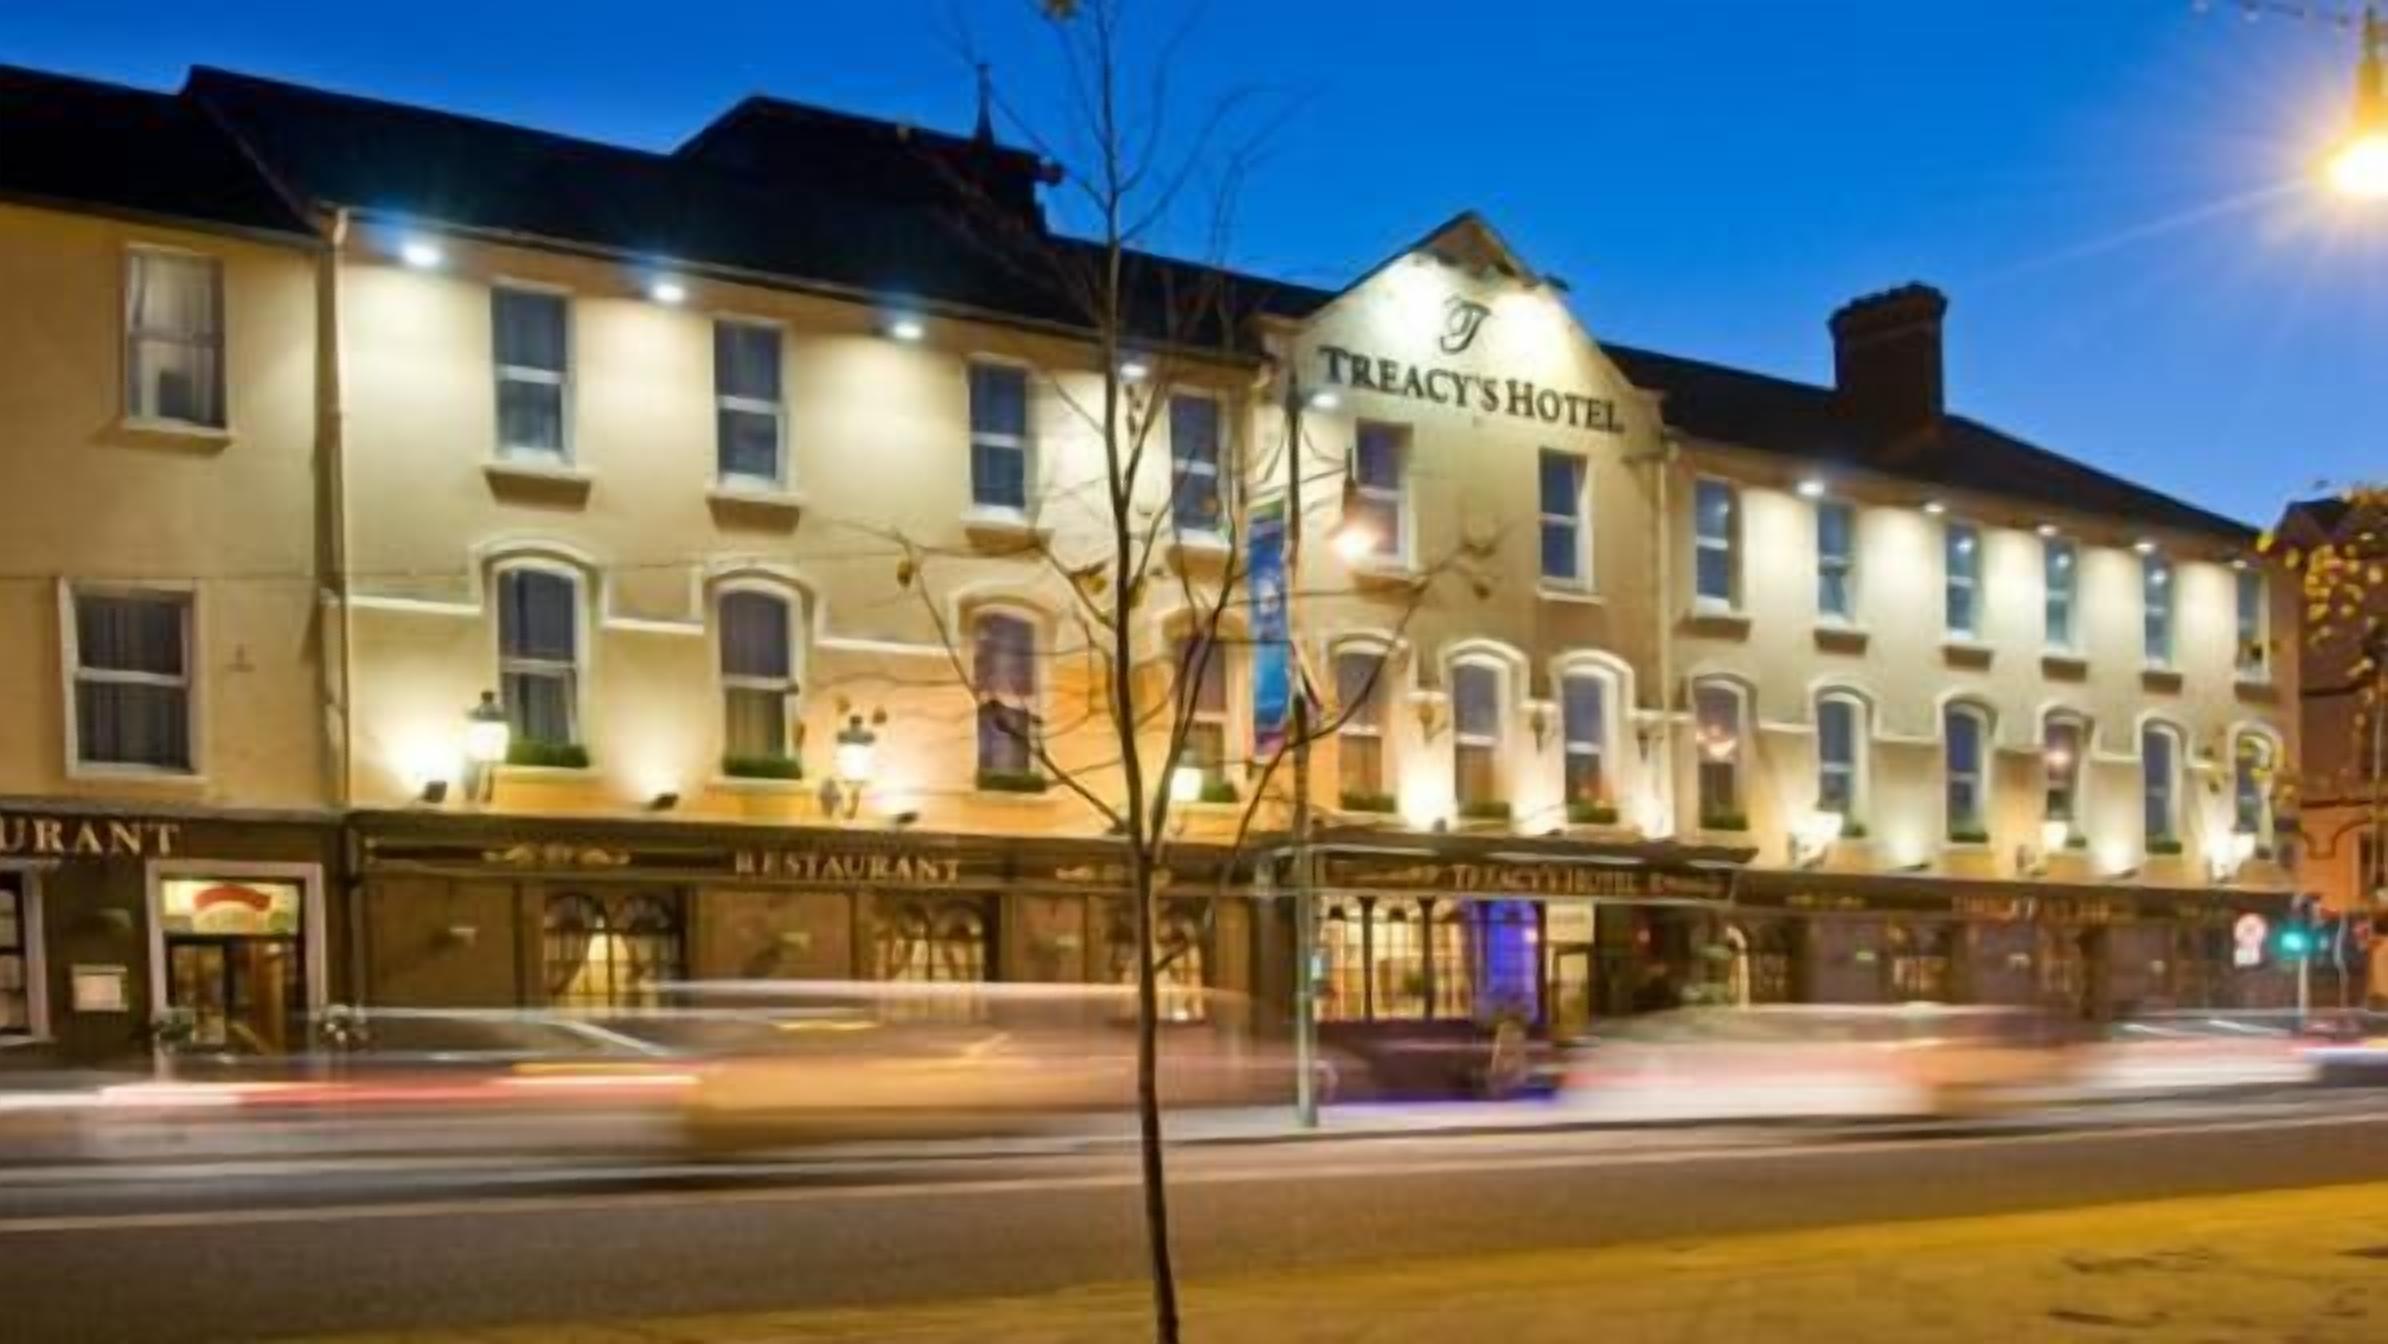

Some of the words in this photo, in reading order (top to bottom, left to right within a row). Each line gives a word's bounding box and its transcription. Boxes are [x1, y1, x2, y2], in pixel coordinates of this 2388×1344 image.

[1317, 345, 1500, 413] TREACY'S
[1505, 379, 1626, 435] HOTEL
[735, 850, 960, 882] RESTAURANT
